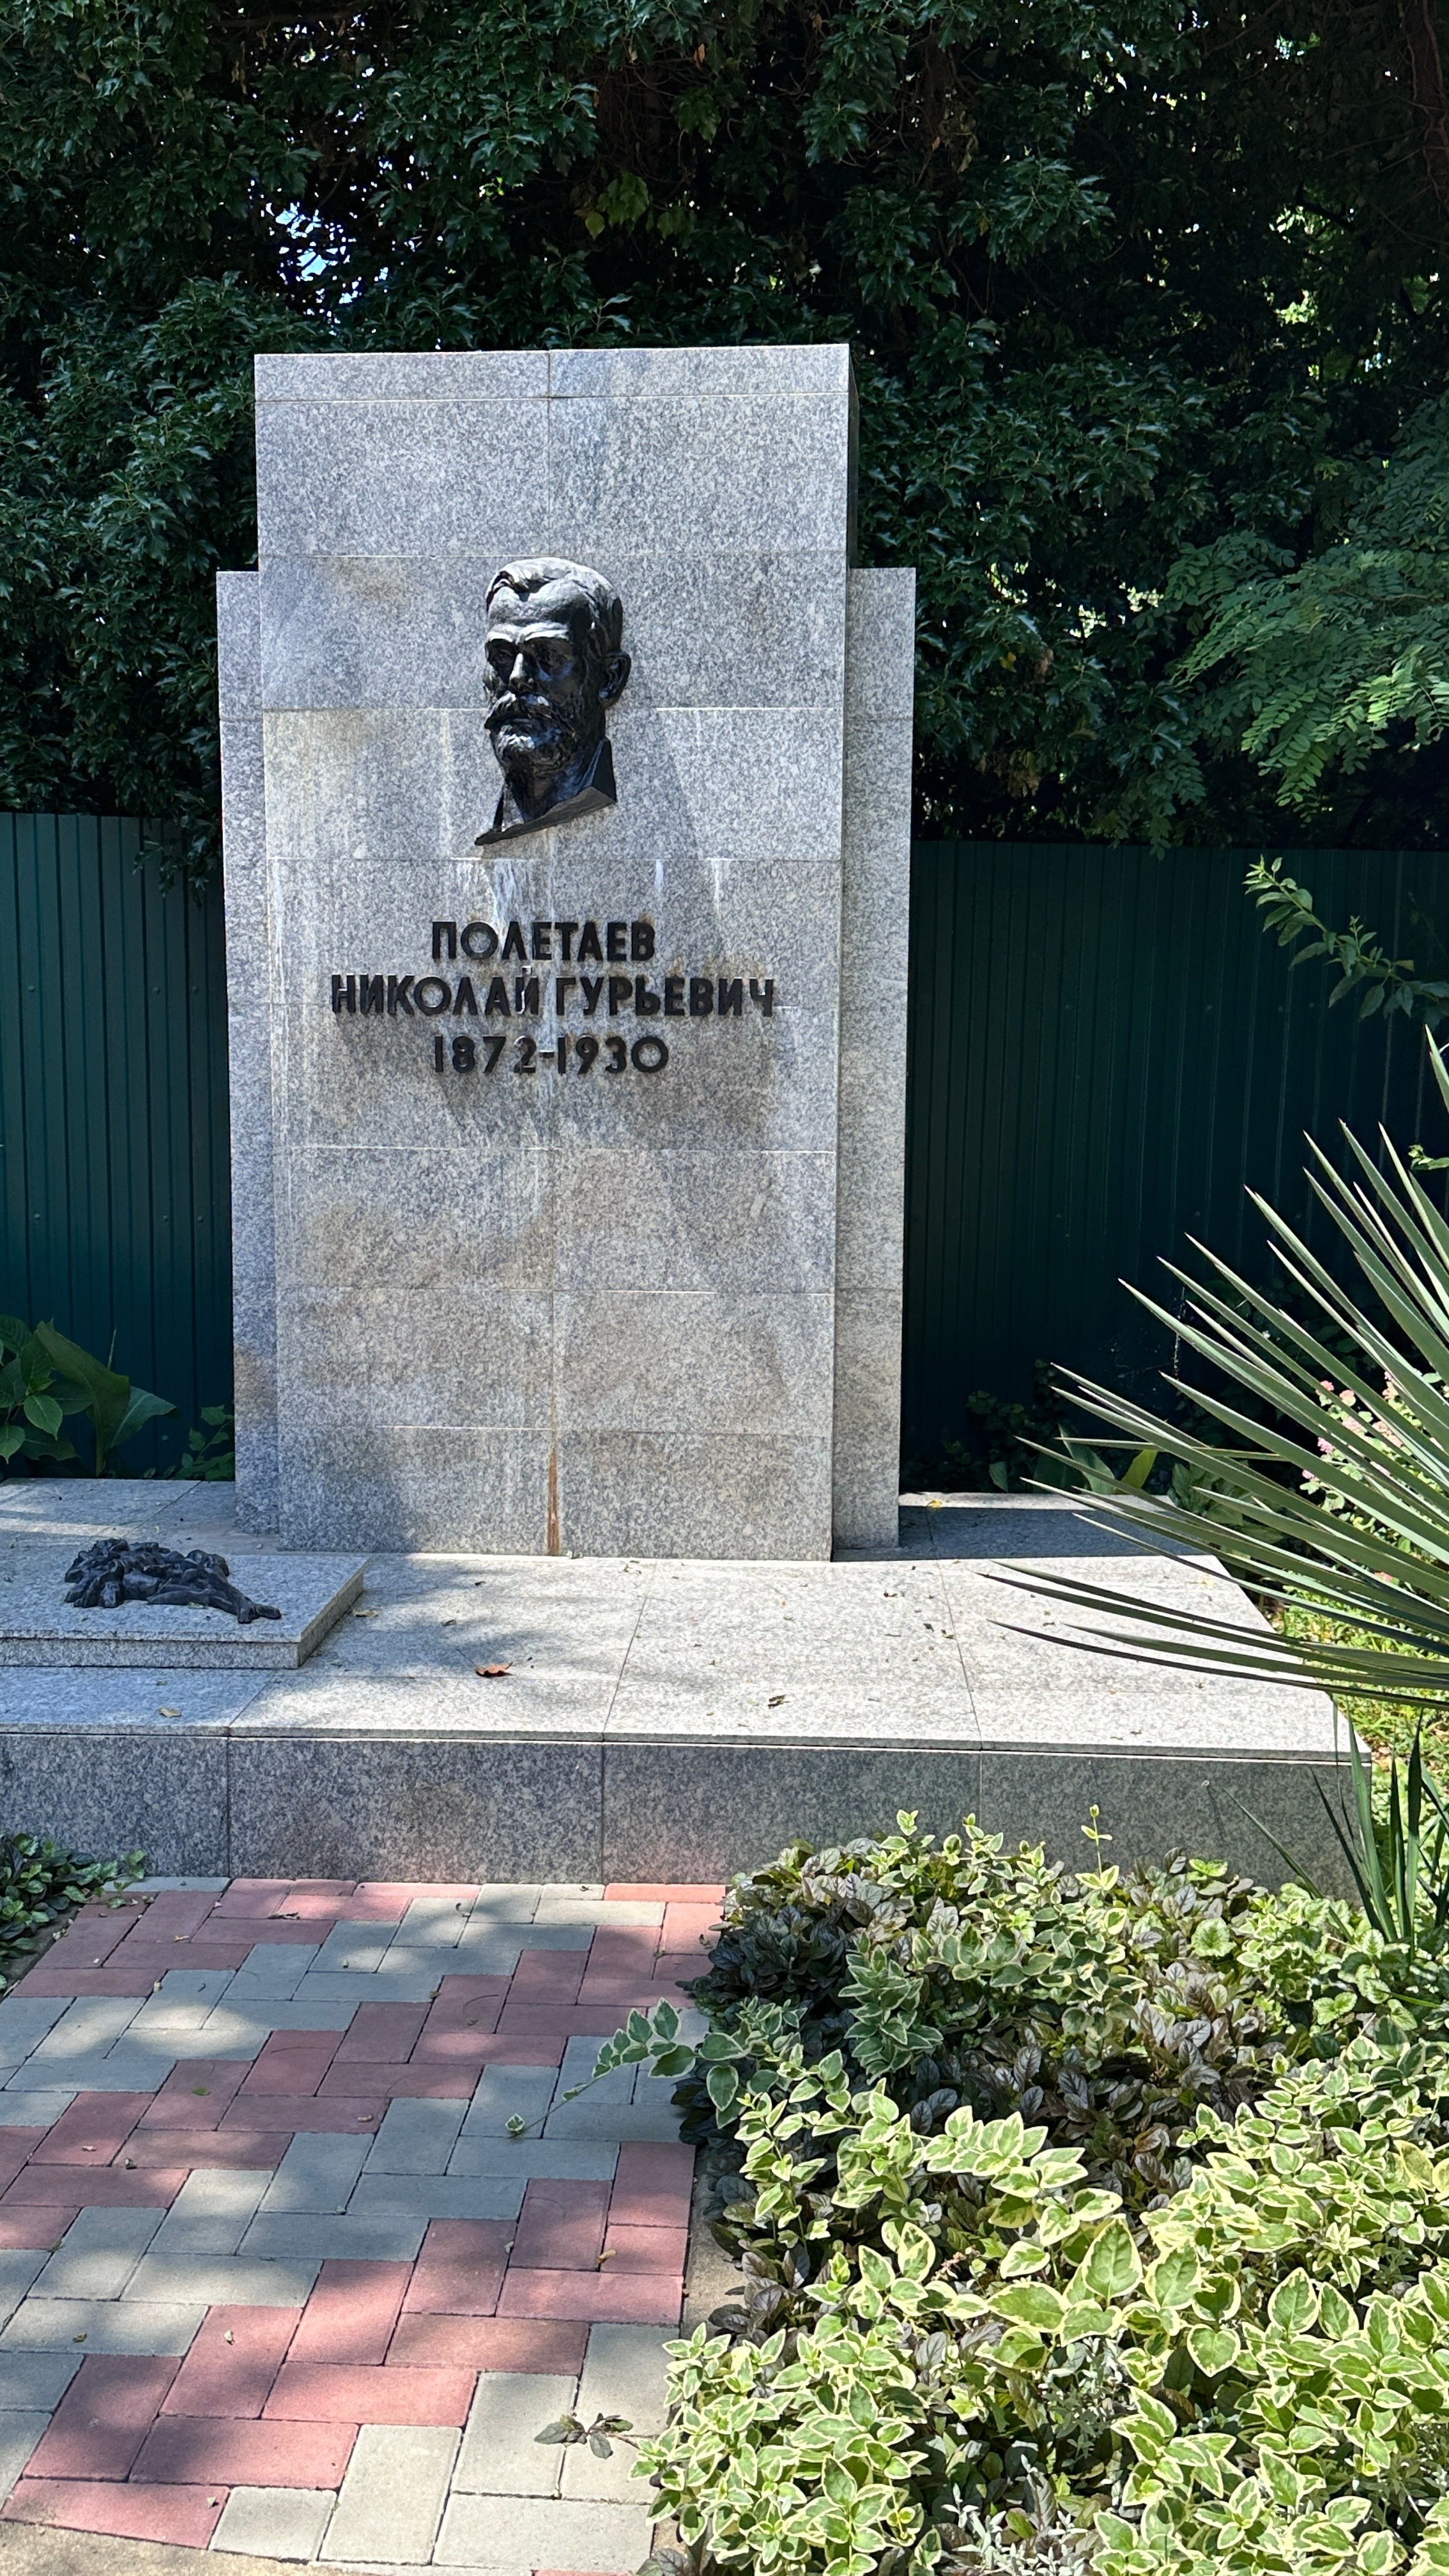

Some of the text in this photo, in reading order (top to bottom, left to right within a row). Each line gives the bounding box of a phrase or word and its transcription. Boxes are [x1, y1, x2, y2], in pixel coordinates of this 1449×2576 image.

[432, 921, 656, 962] ПОЛЕТАЕВ
[331, 965, 774, 1017] НИКОЛАЙ ГУРЬЕВИЧ
[434, 1034, 669, 1075] 1872-1930
